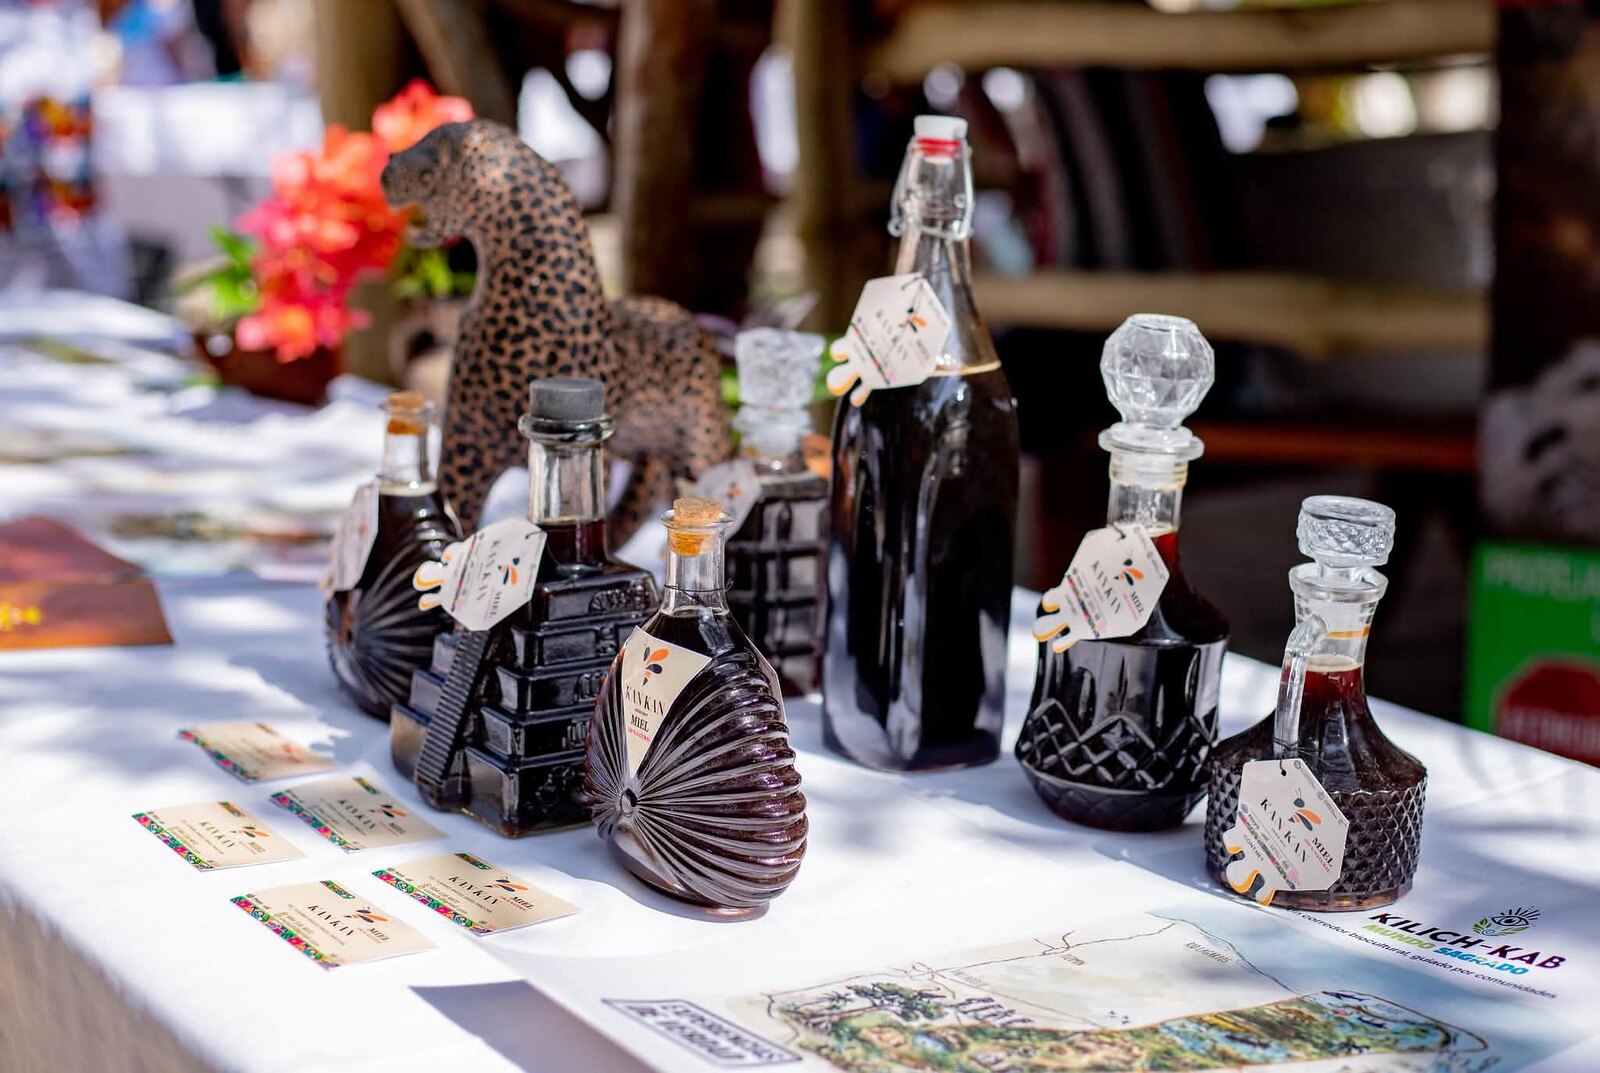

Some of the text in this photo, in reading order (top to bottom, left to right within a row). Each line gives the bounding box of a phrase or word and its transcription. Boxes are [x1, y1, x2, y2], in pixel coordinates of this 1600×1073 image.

[625, 685, 665, 716] KANKAN
[630, 714, 650, 733] MIEL
[1260, 798, 1306, 863] KANKAN
[1312, 837, 1333, 867] MIEL
[449, 876, 498, 905] KANKAN
[510, 896, 534, 910] MIEL
[308, 904, 354, 936] KANKAN
[368, 927, 390, 942] MIEL
[1301, 913, 1351, 935] corredor
[1349, 932, 1410, 957] biocultural,
[1410, 953, 1453, 970] guiado
[1451, 967, 1474, 976] por
[1474, 973, 1557, 999] comunidades
[1363, 924, 1530, 975] MUNDO SAGRADO
[1369, 913, 1567, 969] KILICH-KAB
